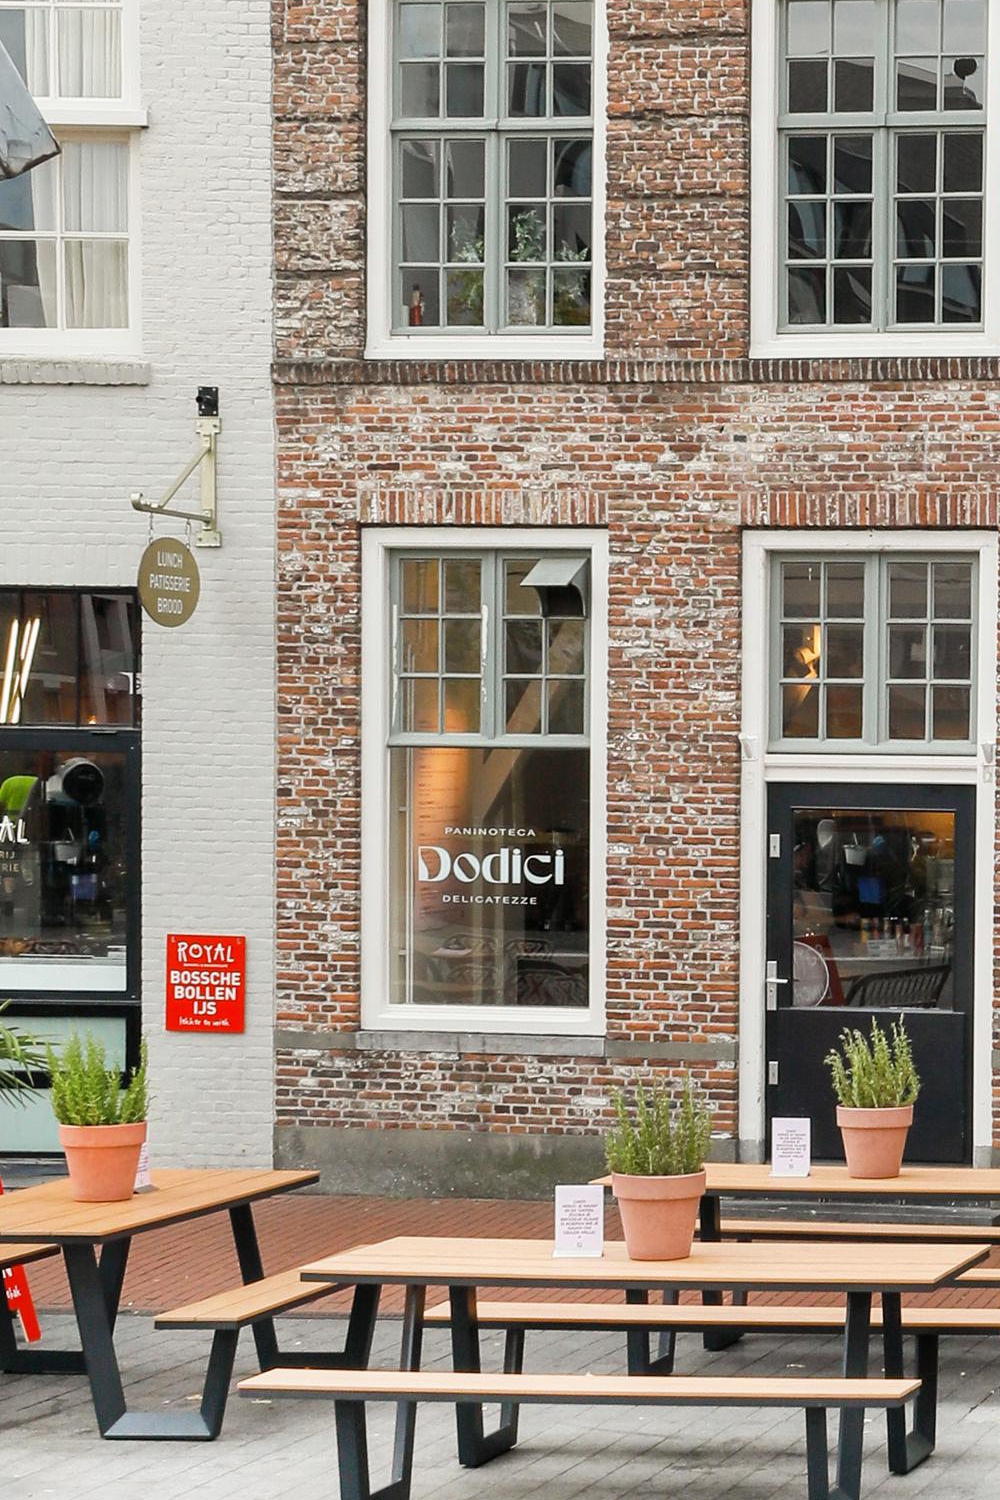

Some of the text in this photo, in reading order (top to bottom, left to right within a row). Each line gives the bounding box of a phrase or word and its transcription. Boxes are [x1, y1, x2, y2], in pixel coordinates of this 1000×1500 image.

[157, 551, 183, 569] LUNCH
[149, 573, 191, 593] PATISSERIE
[157, 597, 183, 614] BROOD
[0, 815, 29, 843] AL
[444, 826, 537, 837] PANINOTECA
[0, 851, 15, 859] RIJ
[1, 863, 20, 872] RIE
[418, 845, 565, 885] Dodici
[442, 894, 537, 905] DELICATEZZE
[177, 941, 235, 963] ROYAL
[170, 970, 241, 986] BOSSCHE
[174, 985, 237, 1001] BOLLEN
[193, 1001, 217, 1015] IJS
